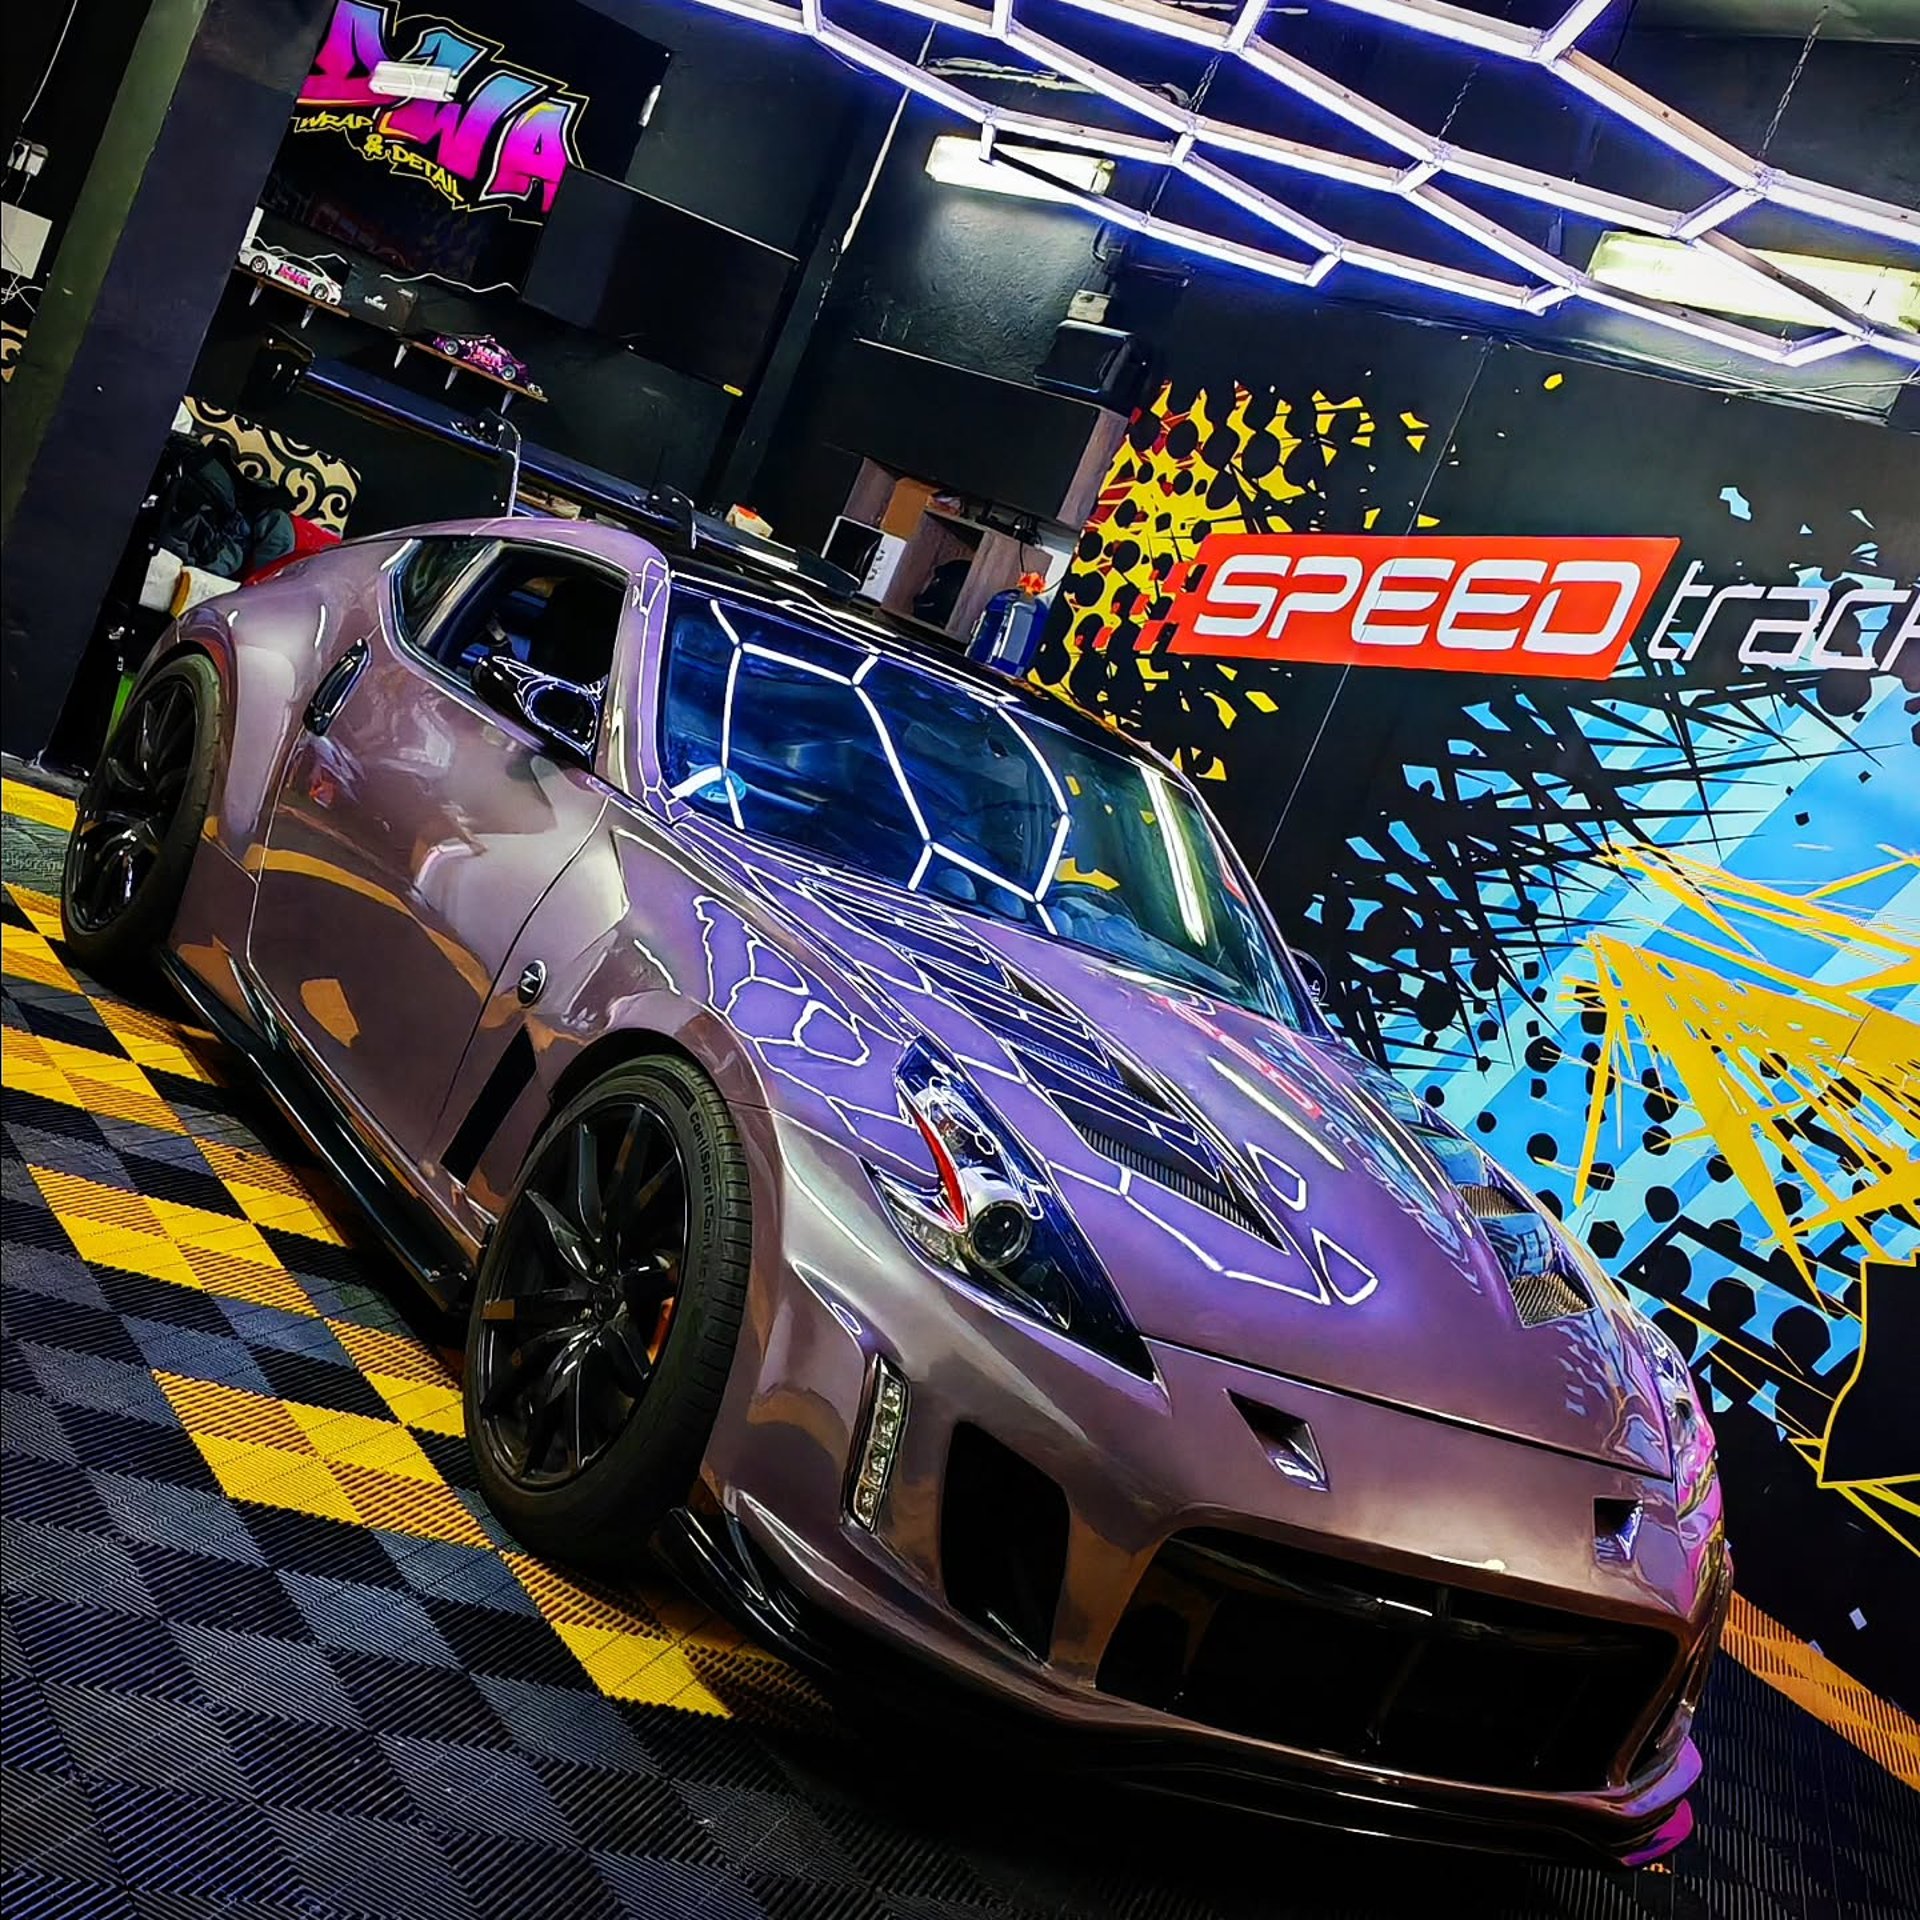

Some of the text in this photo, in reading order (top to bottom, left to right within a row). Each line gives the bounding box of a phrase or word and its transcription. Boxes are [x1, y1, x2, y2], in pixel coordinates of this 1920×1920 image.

[302, 111, 464, 201] WRAP & DETAIL
[1193, 554, 1641, 655] SPEED
